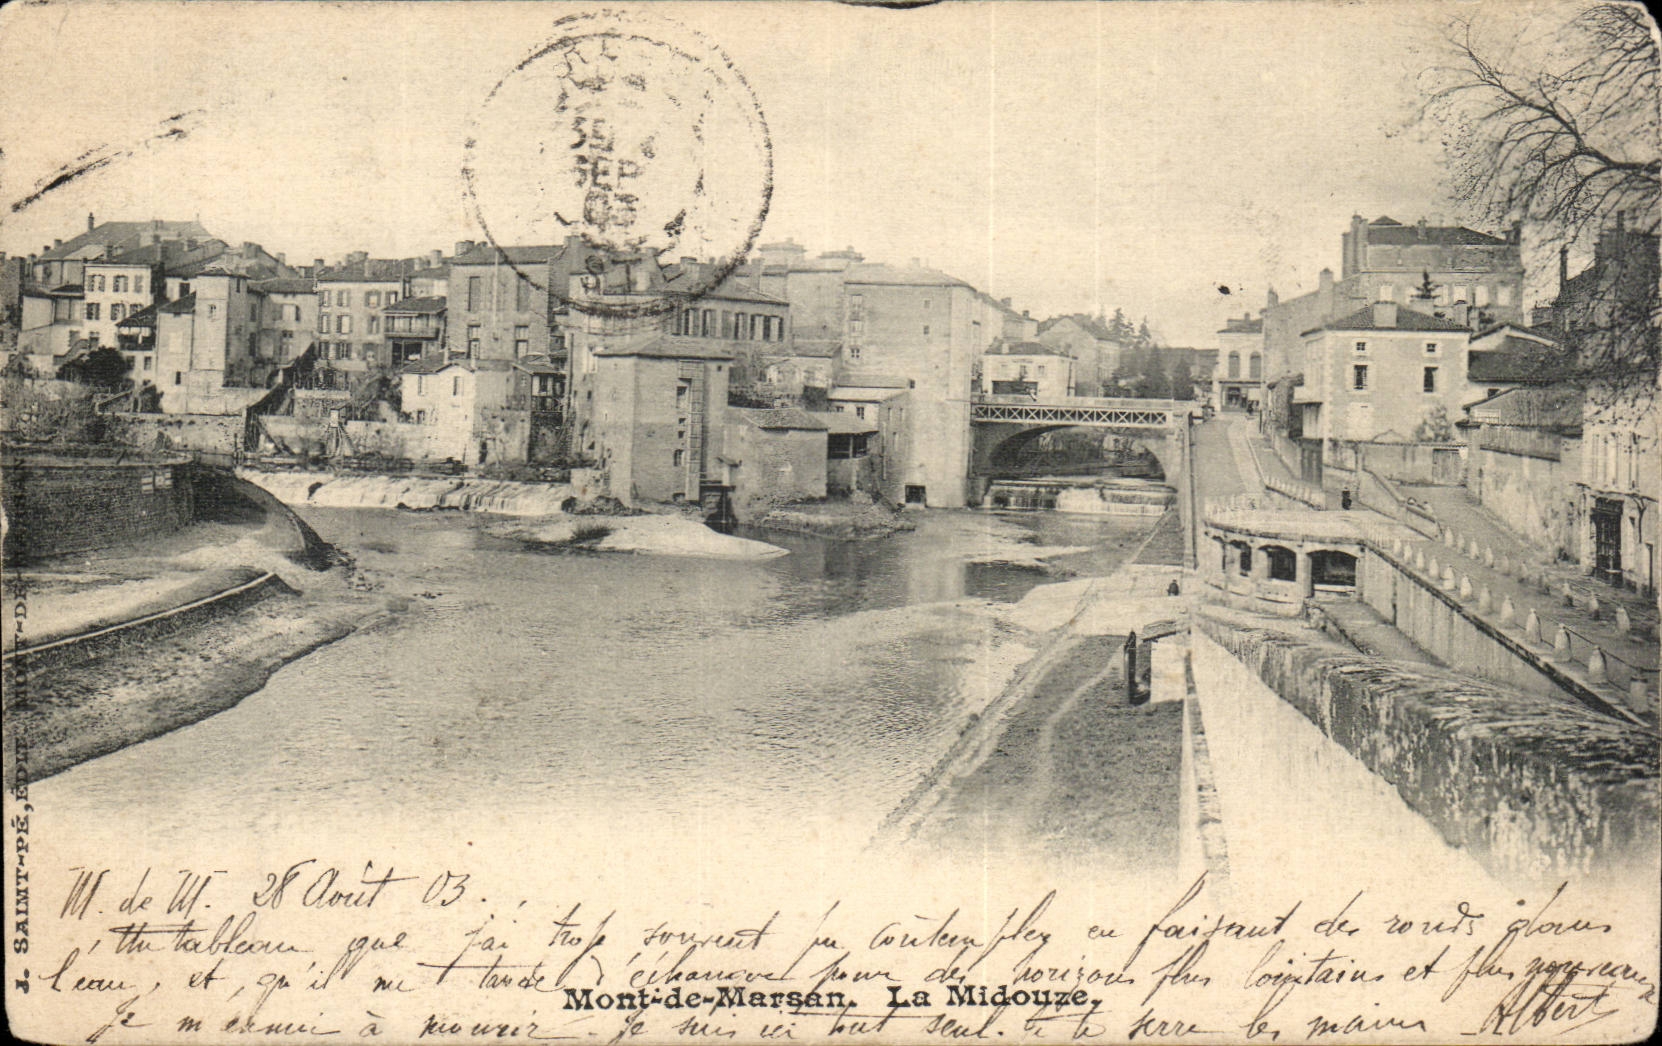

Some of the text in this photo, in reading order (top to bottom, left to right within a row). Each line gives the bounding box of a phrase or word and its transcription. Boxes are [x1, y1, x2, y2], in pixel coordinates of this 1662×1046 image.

[119, 867, 154, 916] de
[172, 911, 313, 957] tableau
[341, 931, 408, 980] que
[548, 902, 616, 986] trop
[643, 910, 777, 950] souvent
[1088, 924, 1124, 941] en
[1122, 869, 1302, 973] faisant
[1244, 939, 1385, 990] lointains
[1403, 945, 1450, 982] et
[358, 1010, 386, 1036] à
[672, 1013, 737, 1039] suis
